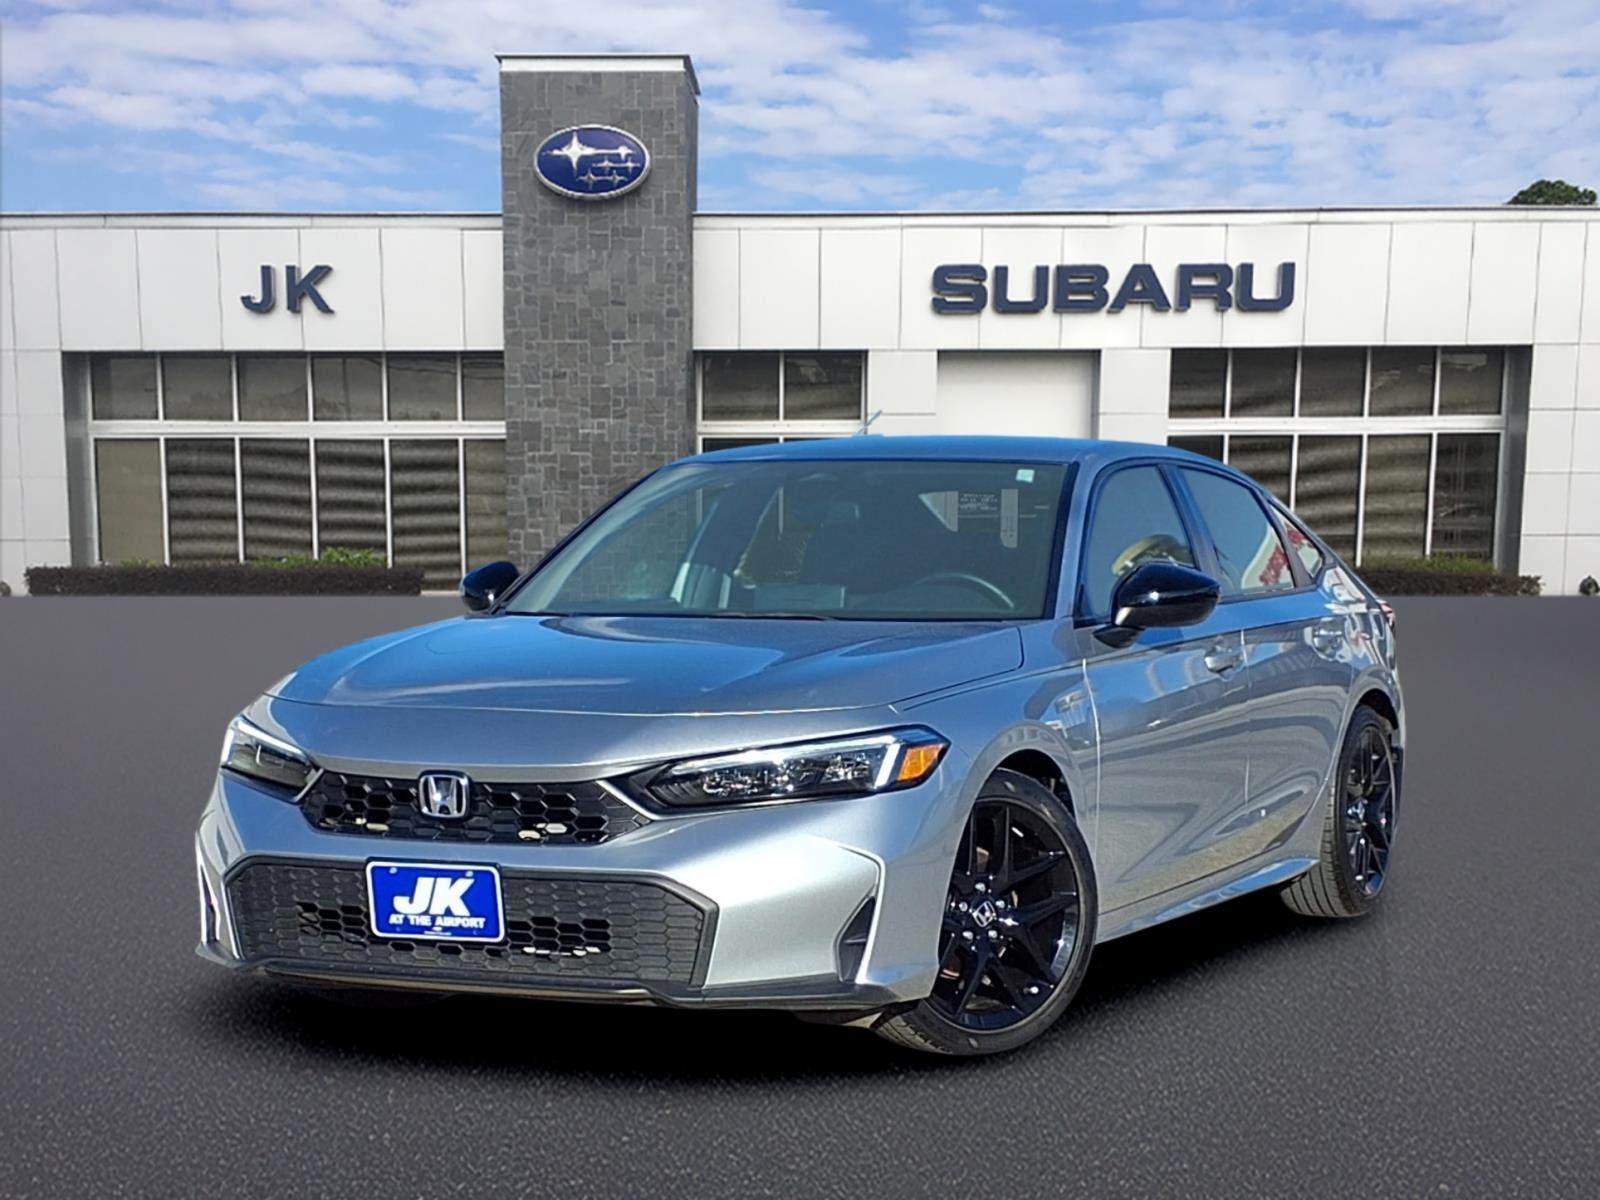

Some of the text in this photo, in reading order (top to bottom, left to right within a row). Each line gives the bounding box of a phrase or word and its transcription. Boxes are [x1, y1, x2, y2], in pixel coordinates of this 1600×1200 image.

[241, 262, 1296, 315] JK SUBARU
[393, 877, 475, 916] JK
[388, 914, 486, 928] AT THE AIRPORT
